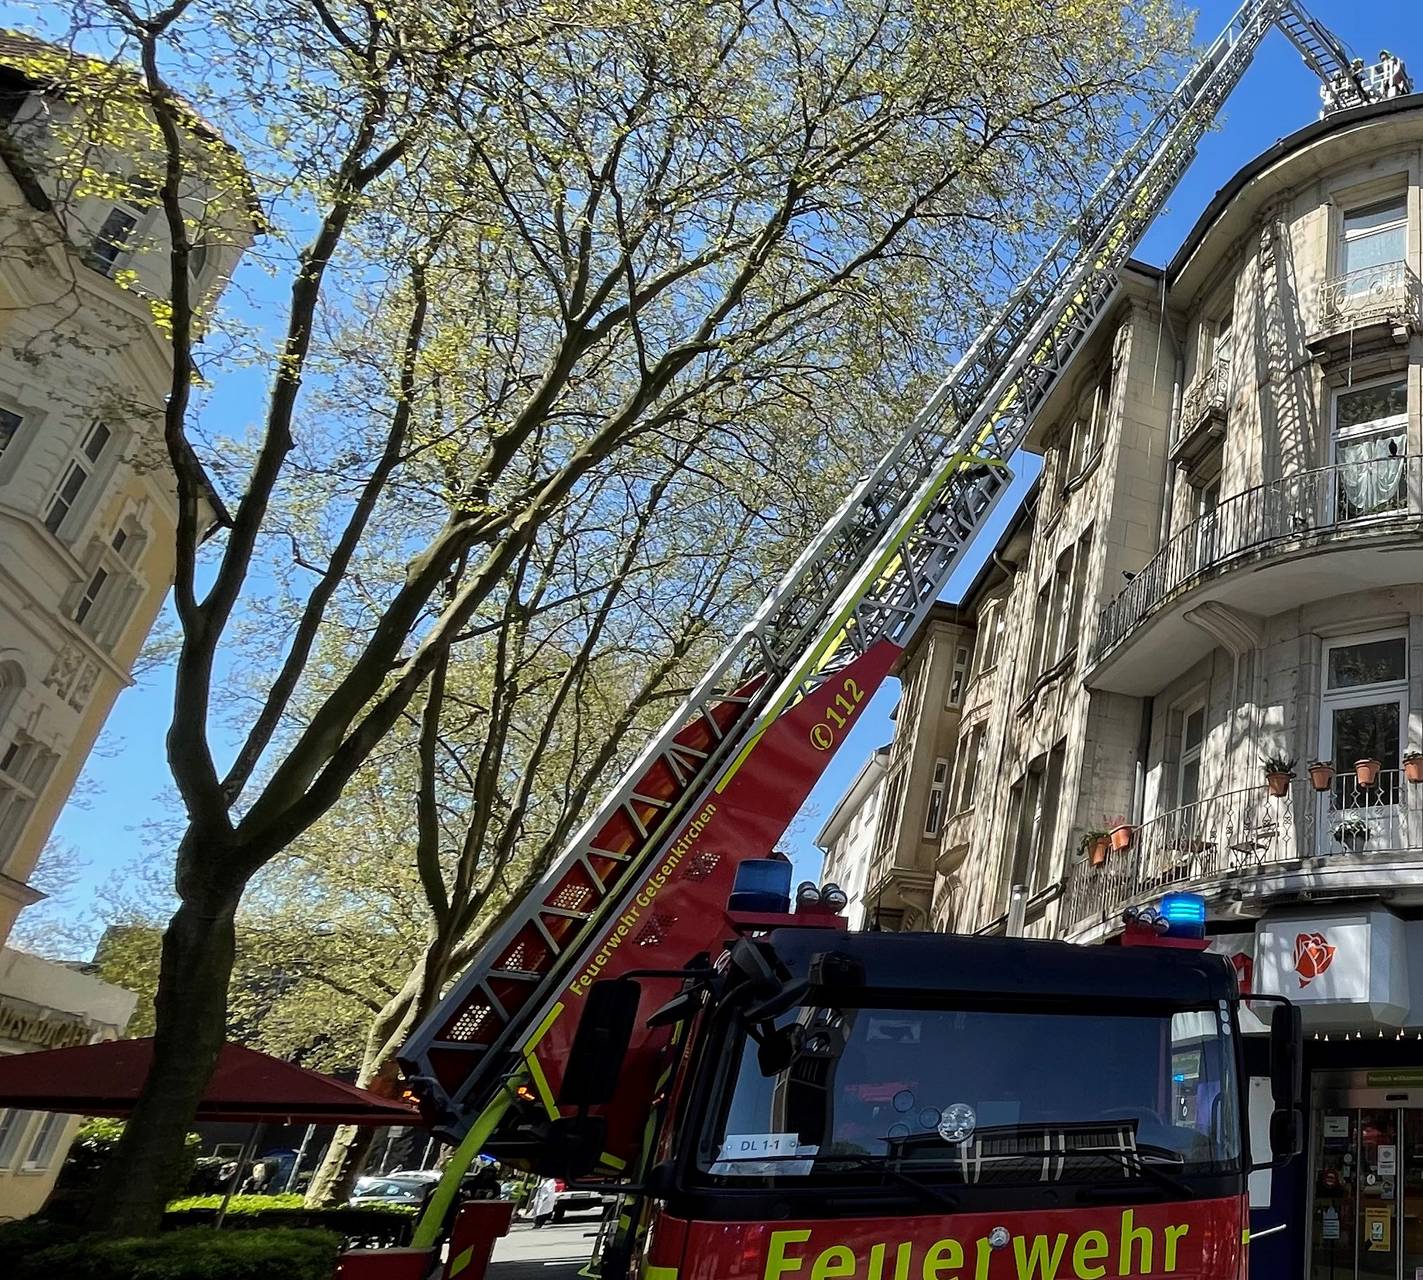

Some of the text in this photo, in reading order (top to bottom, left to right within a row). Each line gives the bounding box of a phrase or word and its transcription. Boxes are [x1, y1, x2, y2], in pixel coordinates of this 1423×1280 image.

[826, 679, 864, 729] 112
[569, 803, 717, 996] Feuerwehr Gelsenkirchen
[741, 1139, 780, 1152] DL 1-1
[763, 1208, 1189, 1280] Feuerwehr
